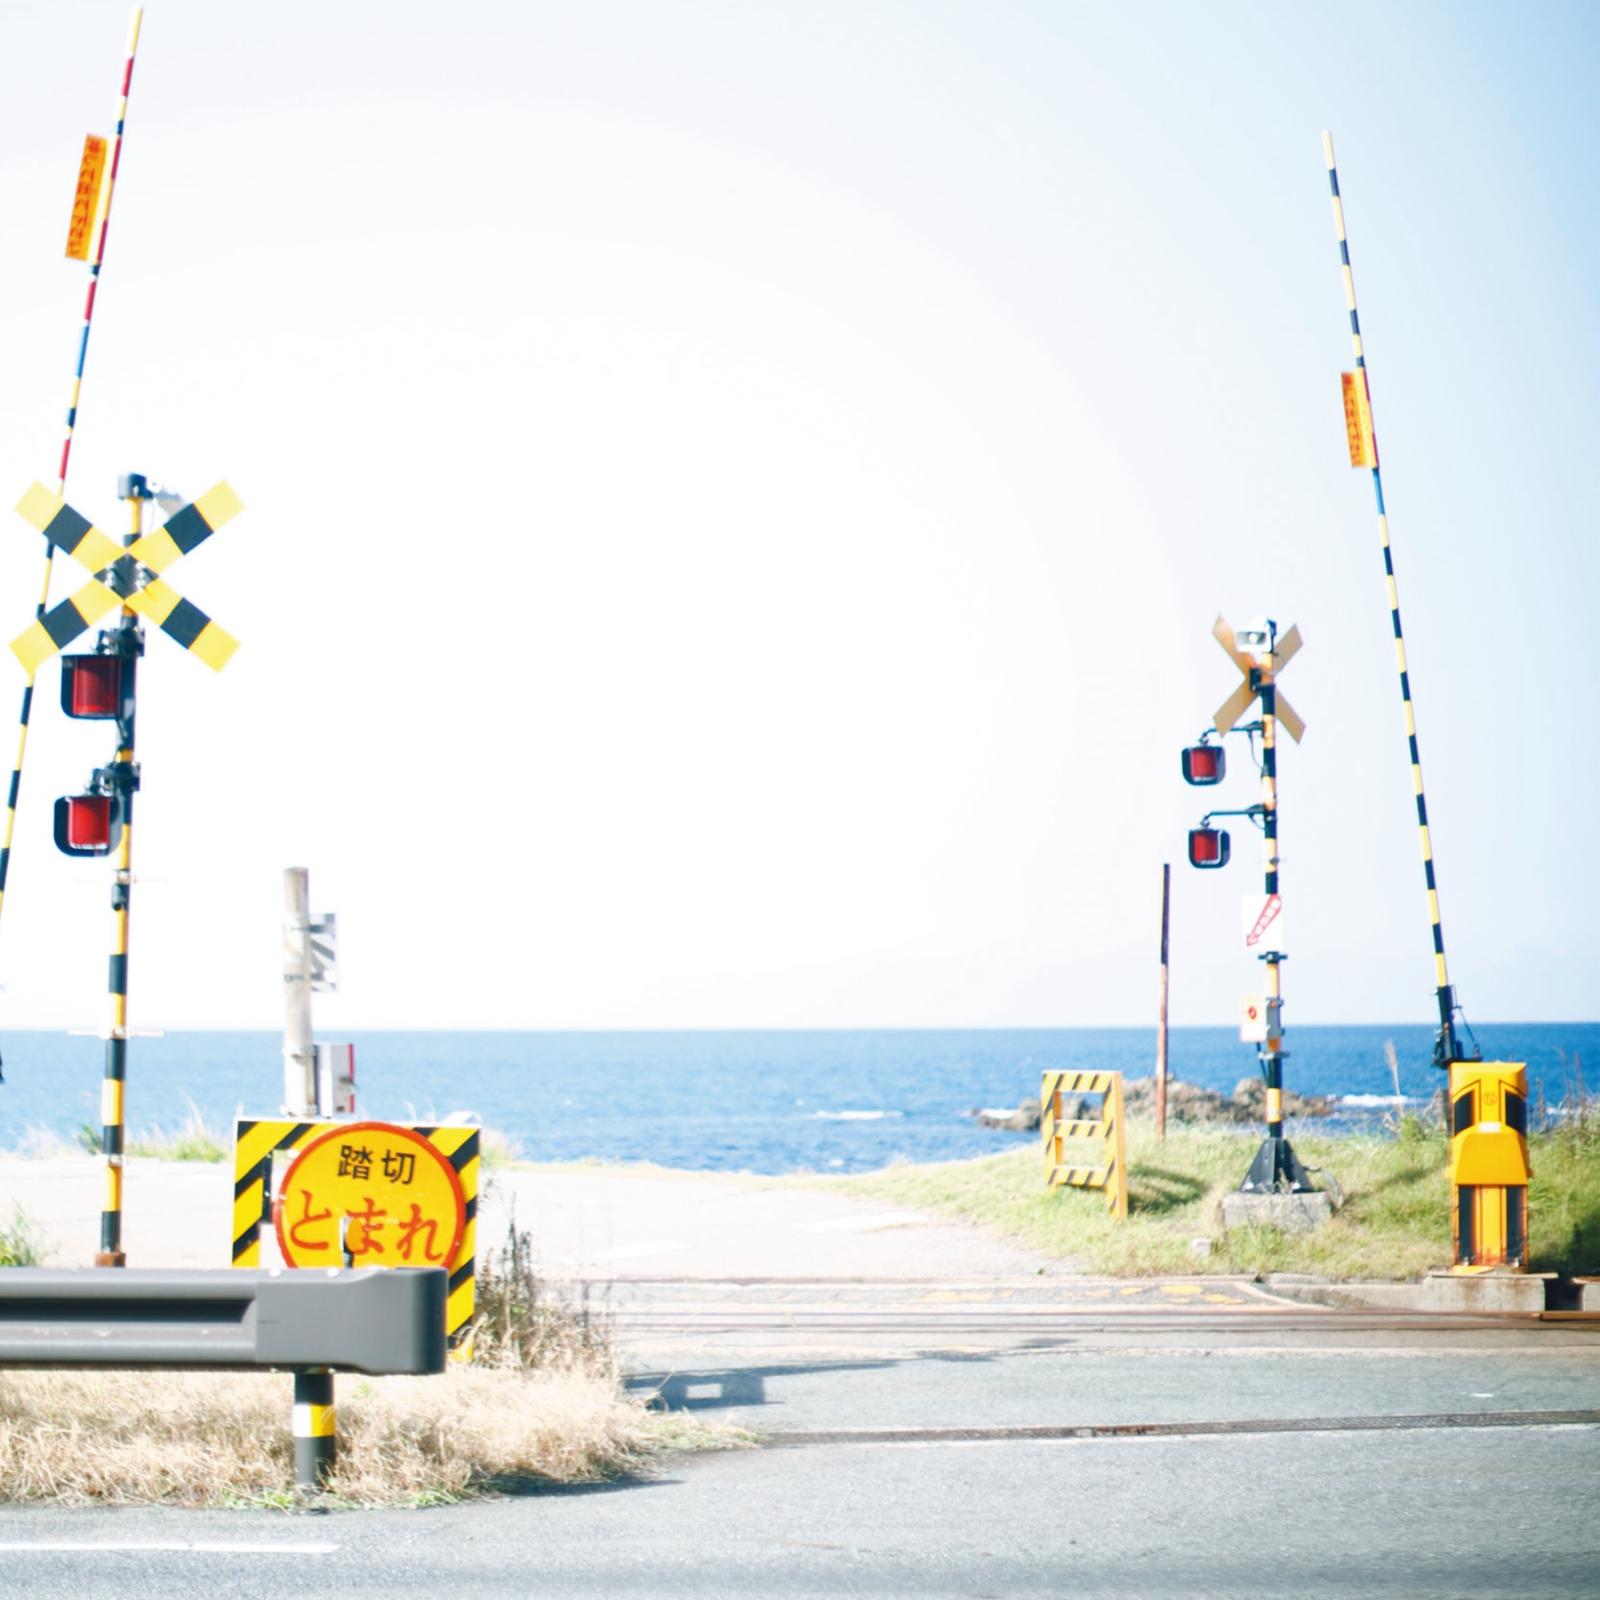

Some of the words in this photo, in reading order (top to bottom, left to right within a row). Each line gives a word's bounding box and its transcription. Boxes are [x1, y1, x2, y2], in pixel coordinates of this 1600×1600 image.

[337, 1144, 416, 1185] 踏切
[290, 1189, 443, 1262] とまれ
